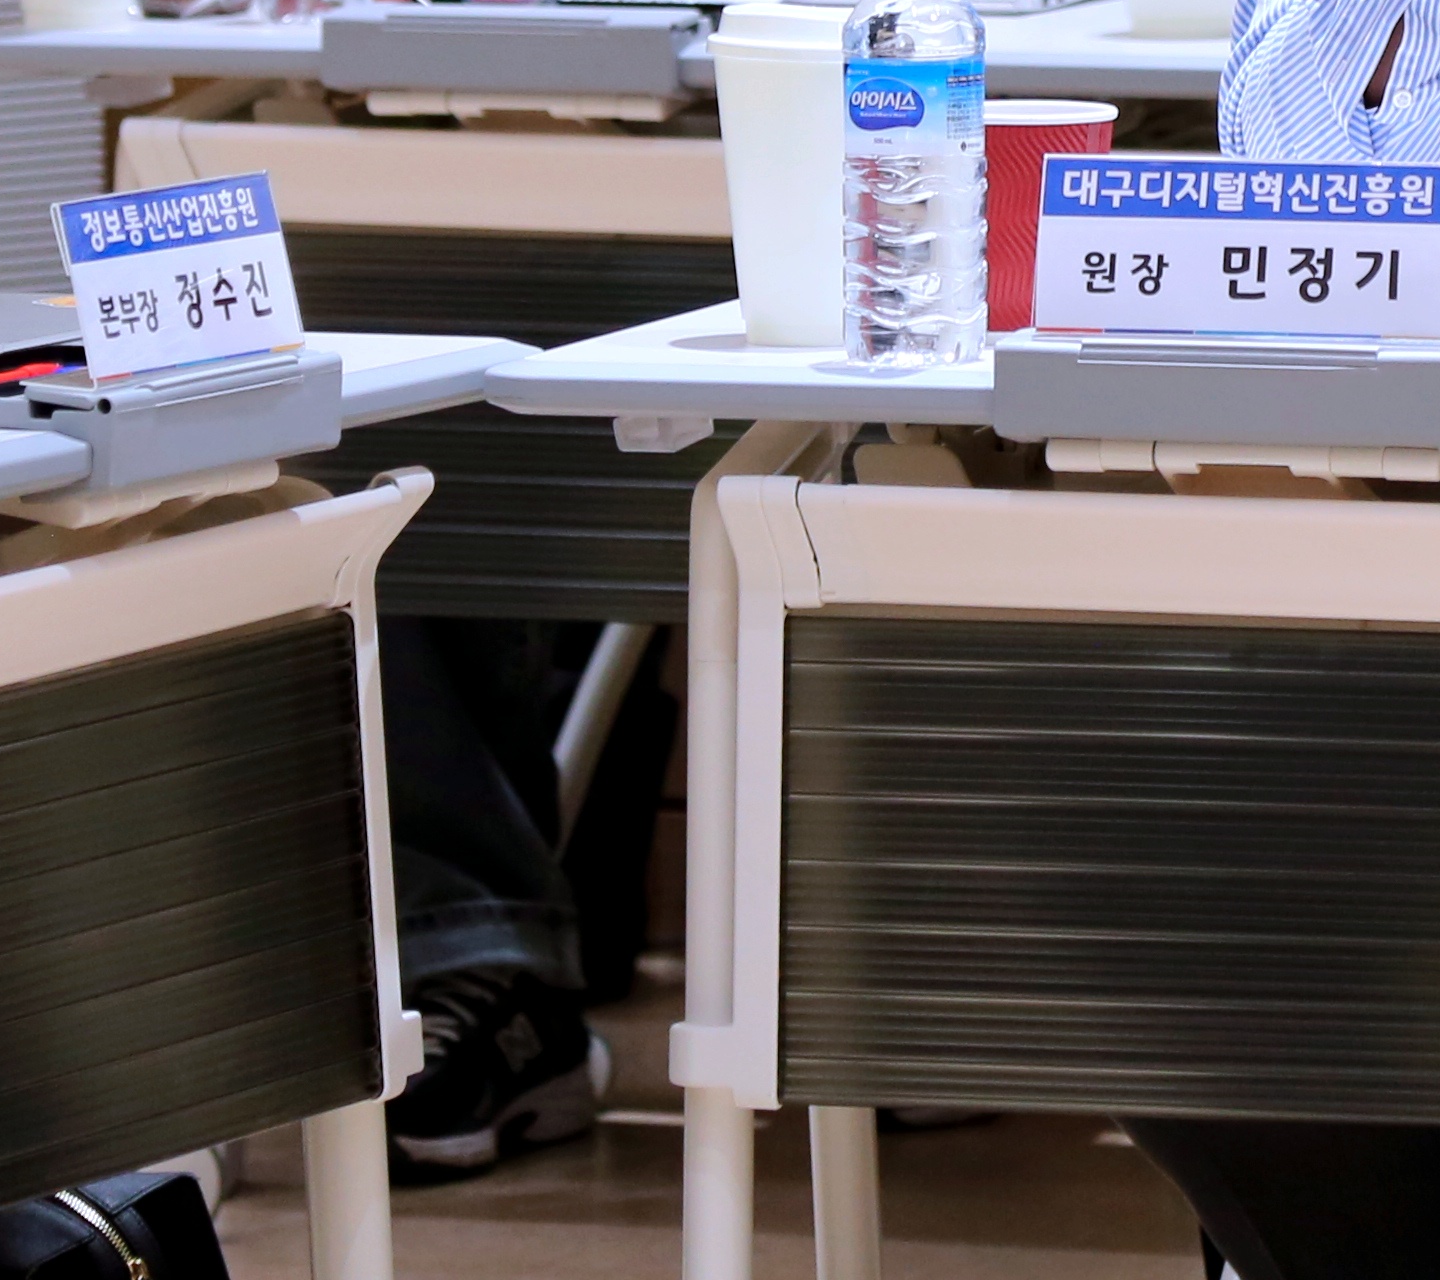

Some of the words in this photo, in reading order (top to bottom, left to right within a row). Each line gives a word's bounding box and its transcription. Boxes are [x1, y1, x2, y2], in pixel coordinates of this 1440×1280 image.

[851, 91, 917, 110] 아이시스
[80, 187, 259, 252] 정보통신산업진흥원
[1061, 169, 1435, 217] 대구디지털혁신진흥원
[98, 289, 159, 339] 본부장
[175, 261, 273, 329] 정수진
[1081, 250, 1170, 296] 원장
[1221, 245, 1402, 303] 민정기
